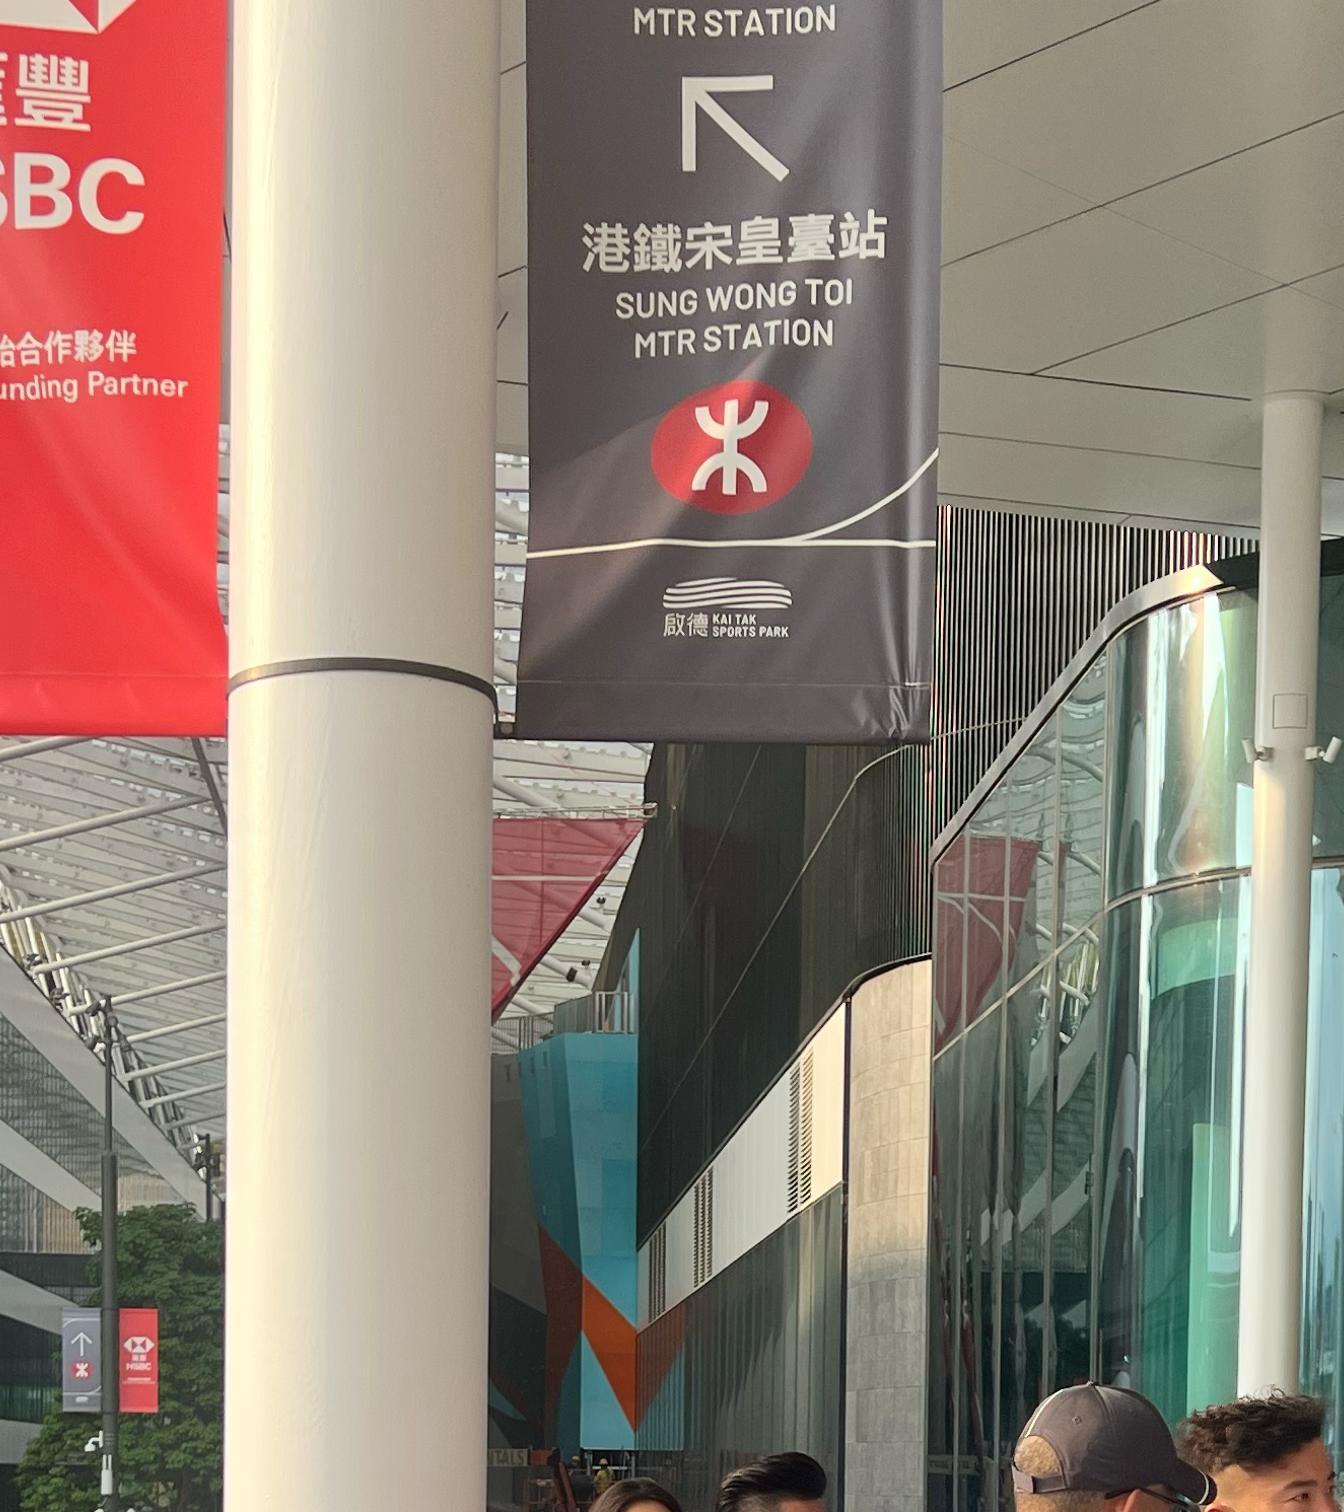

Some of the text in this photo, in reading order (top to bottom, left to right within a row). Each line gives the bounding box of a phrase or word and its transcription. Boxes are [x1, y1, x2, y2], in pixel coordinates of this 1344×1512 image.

[633, 5, 836, 37] MTR STATION
[582, 208, 888, 273] 港鐵宋皇臺站
[615, 278, 854, 320] SUNG WONG TOI
[634, 319, 834, 359] MTR STATION
[88, 371, 188, 397] Partner
[663, 612, 709, 638] 啟德
[712, 613, 757, 625] KAI TAK
[712, 625, 789, 638] SPORTS PARK
